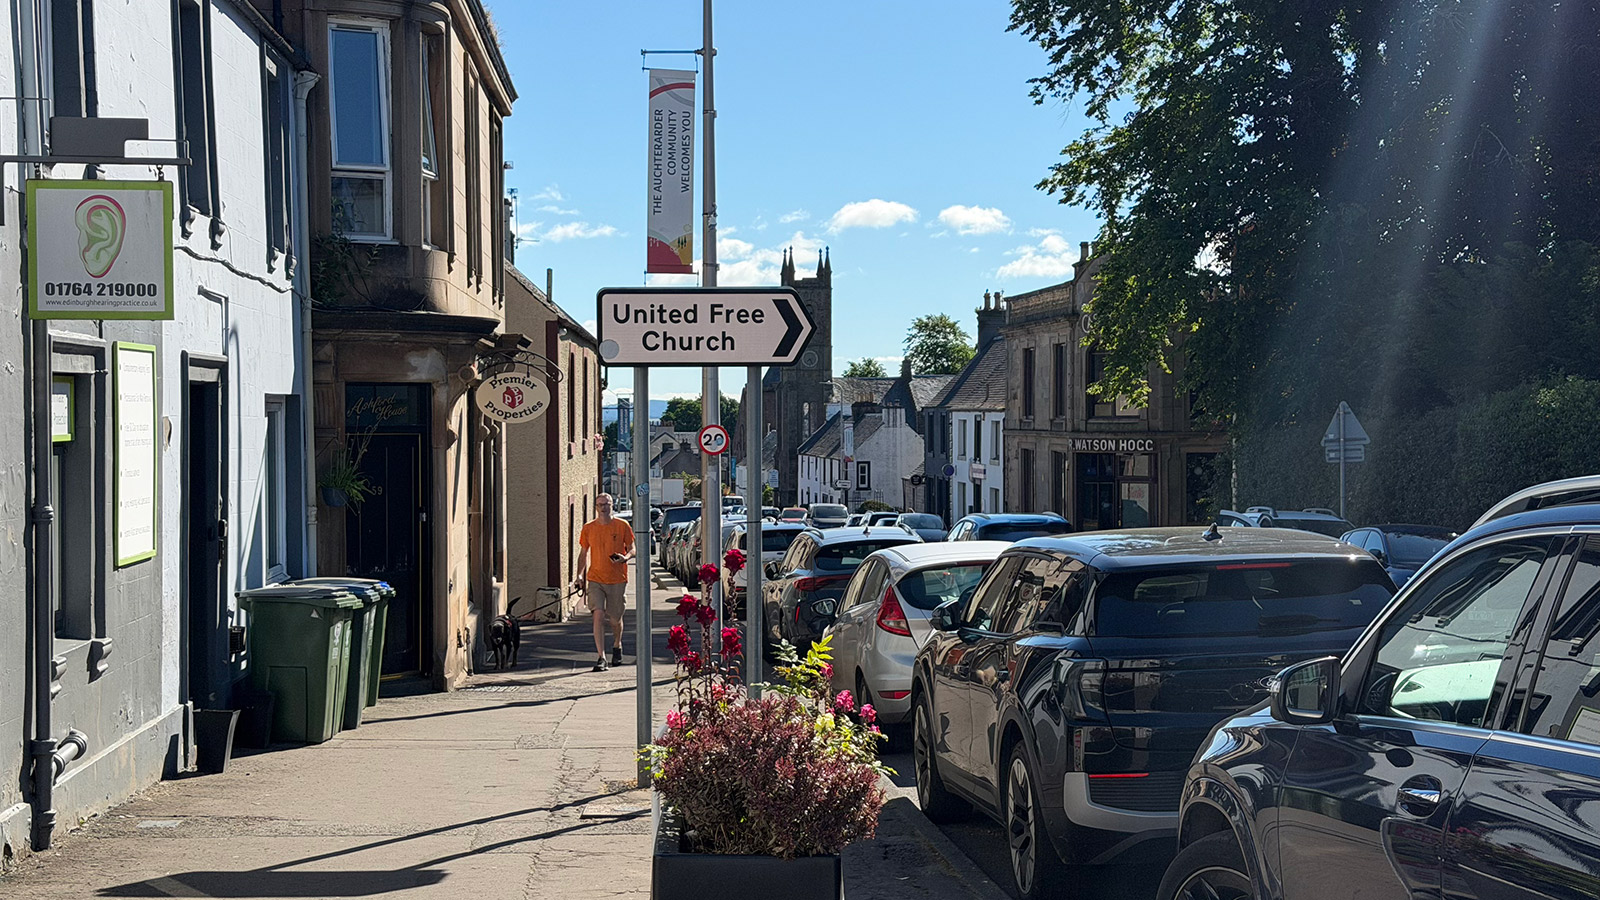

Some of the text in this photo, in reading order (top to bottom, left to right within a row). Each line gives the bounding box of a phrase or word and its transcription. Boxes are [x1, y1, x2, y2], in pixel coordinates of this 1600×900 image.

[667, 109, 677, 176] COMMUNITY
[681, 110, 691, 193] WELCOMES YOU
[653, 109, 663, 215] THE AUCHTERARDER
[45, 282, 157, 297] 01764 219000
[45, 298, 157, 307] www.edinburghhearingpractice.co.uk
[613, 303, 765, 324] United Free
[642, 330, 735, 351] Church
[489, 376, 537, 390] Premier
[347, 393, 396, 417] Ashford
[374, 404, 408, 420] House
[484, 399, 544, 419] Properties
[372, 485, 383, 496] 59
